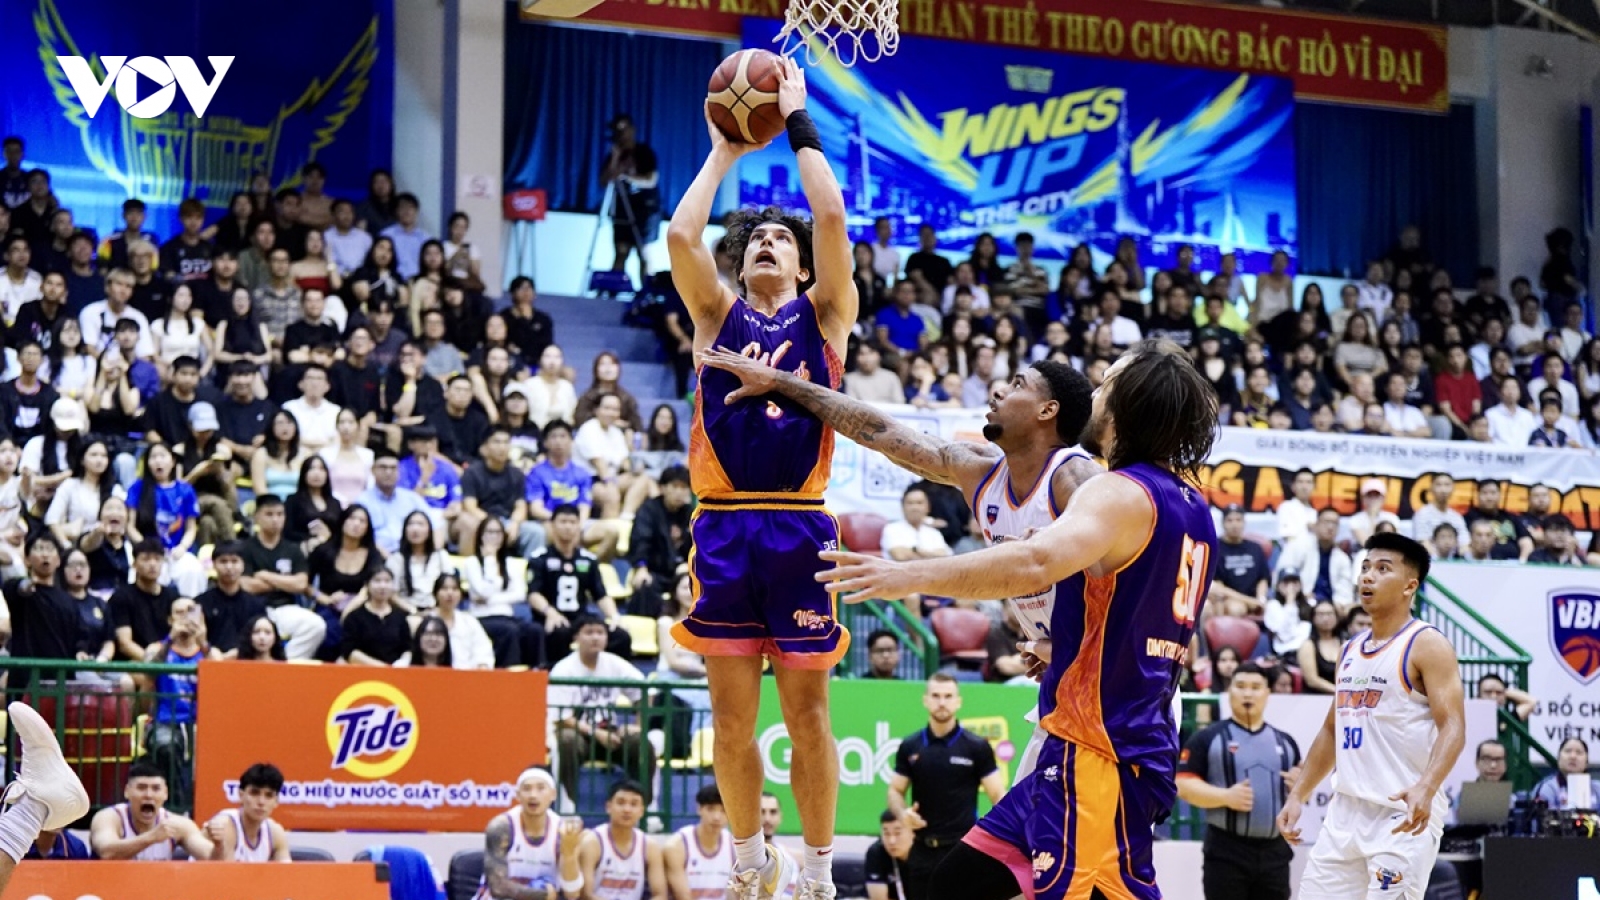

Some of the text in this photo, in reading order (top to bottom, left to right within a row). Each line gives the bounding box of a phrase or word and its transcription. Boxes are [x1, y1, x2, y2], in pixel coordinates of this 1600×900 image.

[1046, 11, 1125, 56] THEO
[1131, 18, 1230, 67] GƯƠNG
[1237, 22, 1292, 72] BÁC
[1378, 45, 1423, 94] ĐẠI
[937, 86, 1127, 160] WINGS
[971, 132, 1088, 205] UP
[973, 190, 1076, 227] THE CITY
[1251, 467, 1285, 511] A
[557, 575, 580, 612] 8
[1172, 532, 1209, 629] 51
[334, 708, 412, 765] Tide
[1343, 726, 1363, 749] 30
[476, 788, 481, 800] 1
